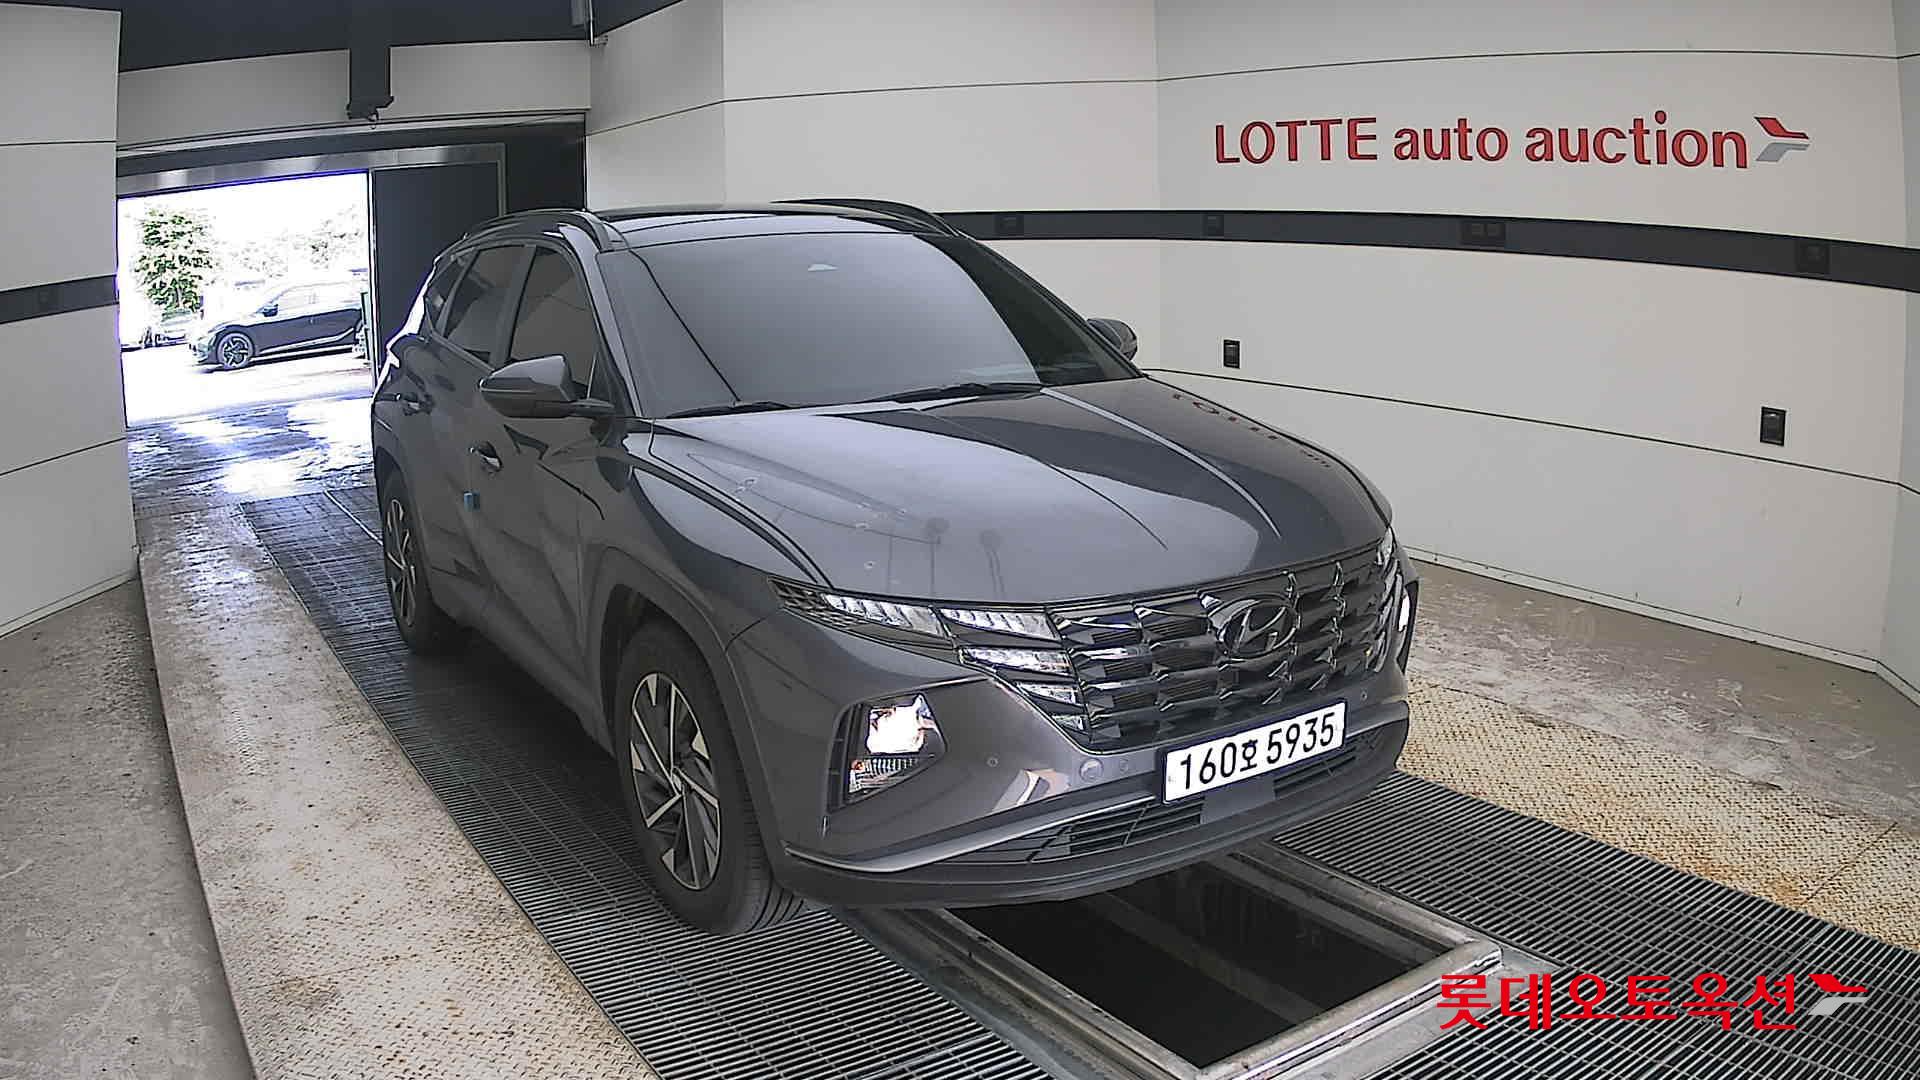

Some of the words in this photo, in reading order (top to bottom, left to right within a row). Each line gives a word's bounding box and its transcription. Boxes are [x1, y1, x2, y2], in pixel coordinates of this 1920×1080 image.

[1214, 117, 1378, 164] LOTTE
[1393, 117, 1509, 162] auto
[1525, 110, 1748, 169] auction
[1180, 739, 1258, 790] 160호
[1266, 712, 1335, 764] 5935
